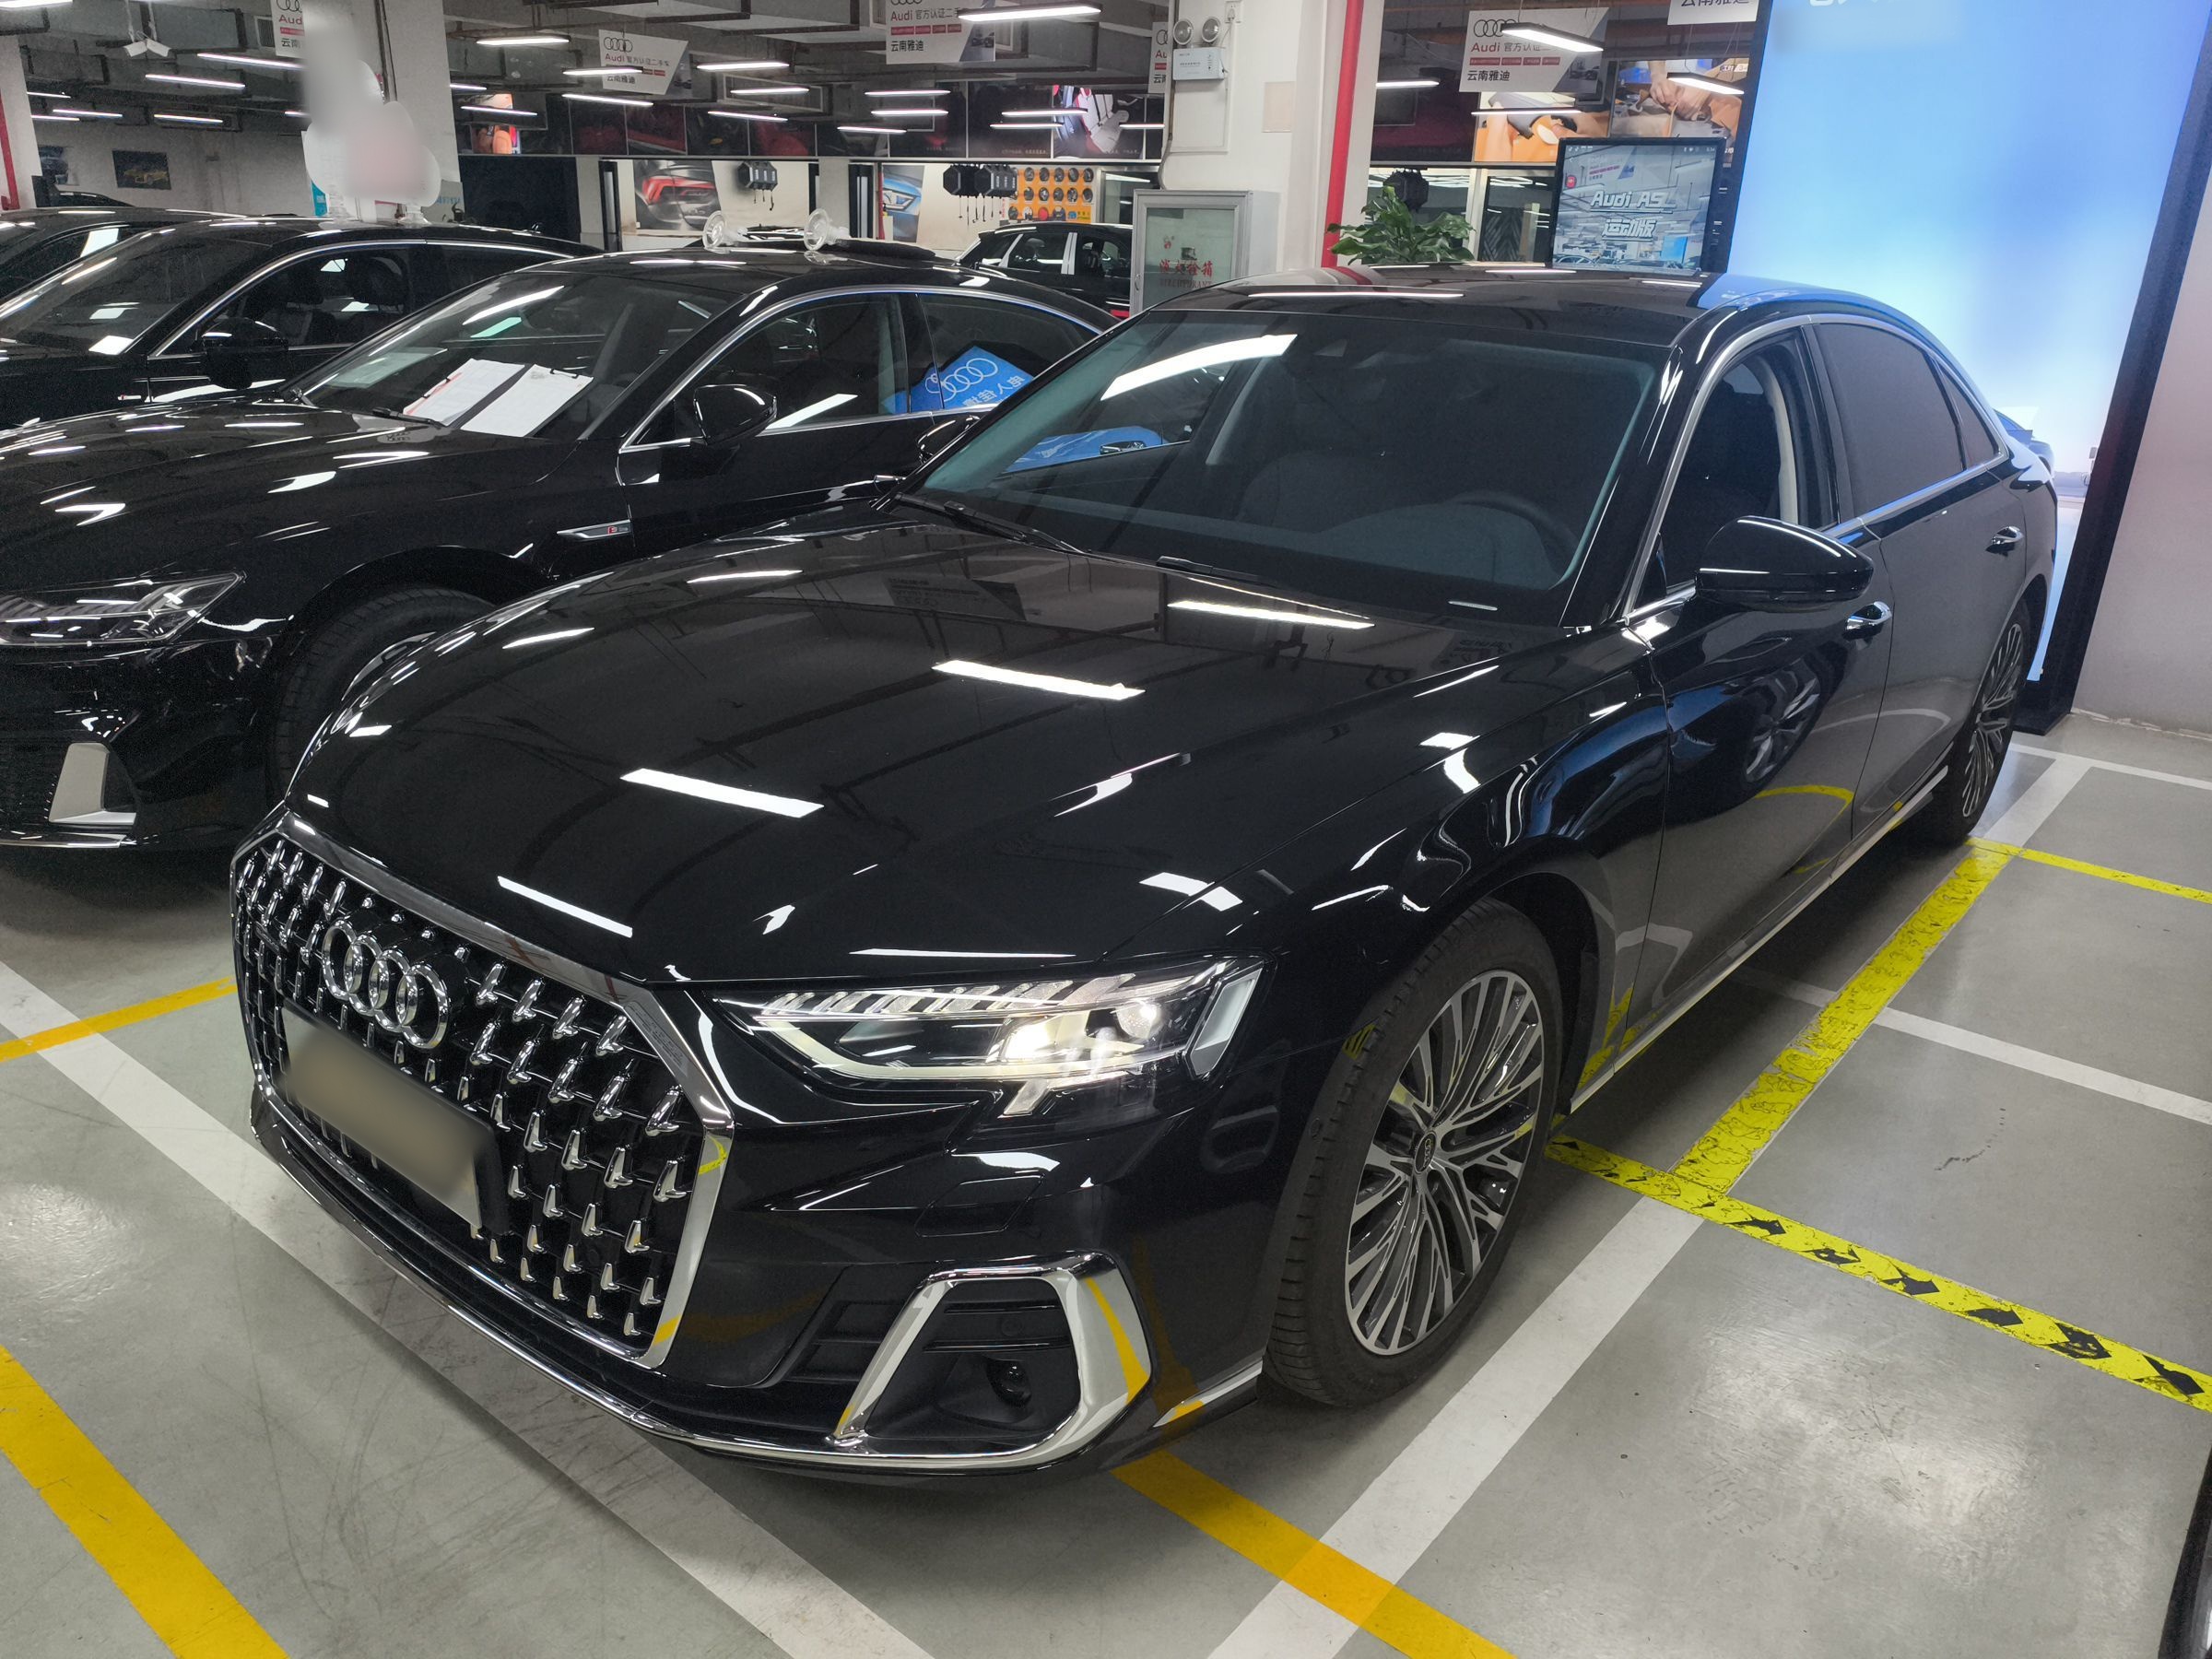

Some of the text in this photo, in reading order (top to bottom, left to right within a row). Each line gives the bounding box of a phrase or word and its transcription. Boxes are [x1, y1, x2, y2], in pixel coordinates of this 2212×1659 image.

[891, 9, 912, 21] Audi
[890, 40, 924, 53] 云南雅迪
[1471, 41, 1500, 53] Audi
[605, 53, 625, 63] Audi
[1467, 70, 1511, 81] 云南雅迪
[1590, 190, 1632, 208] Audi
